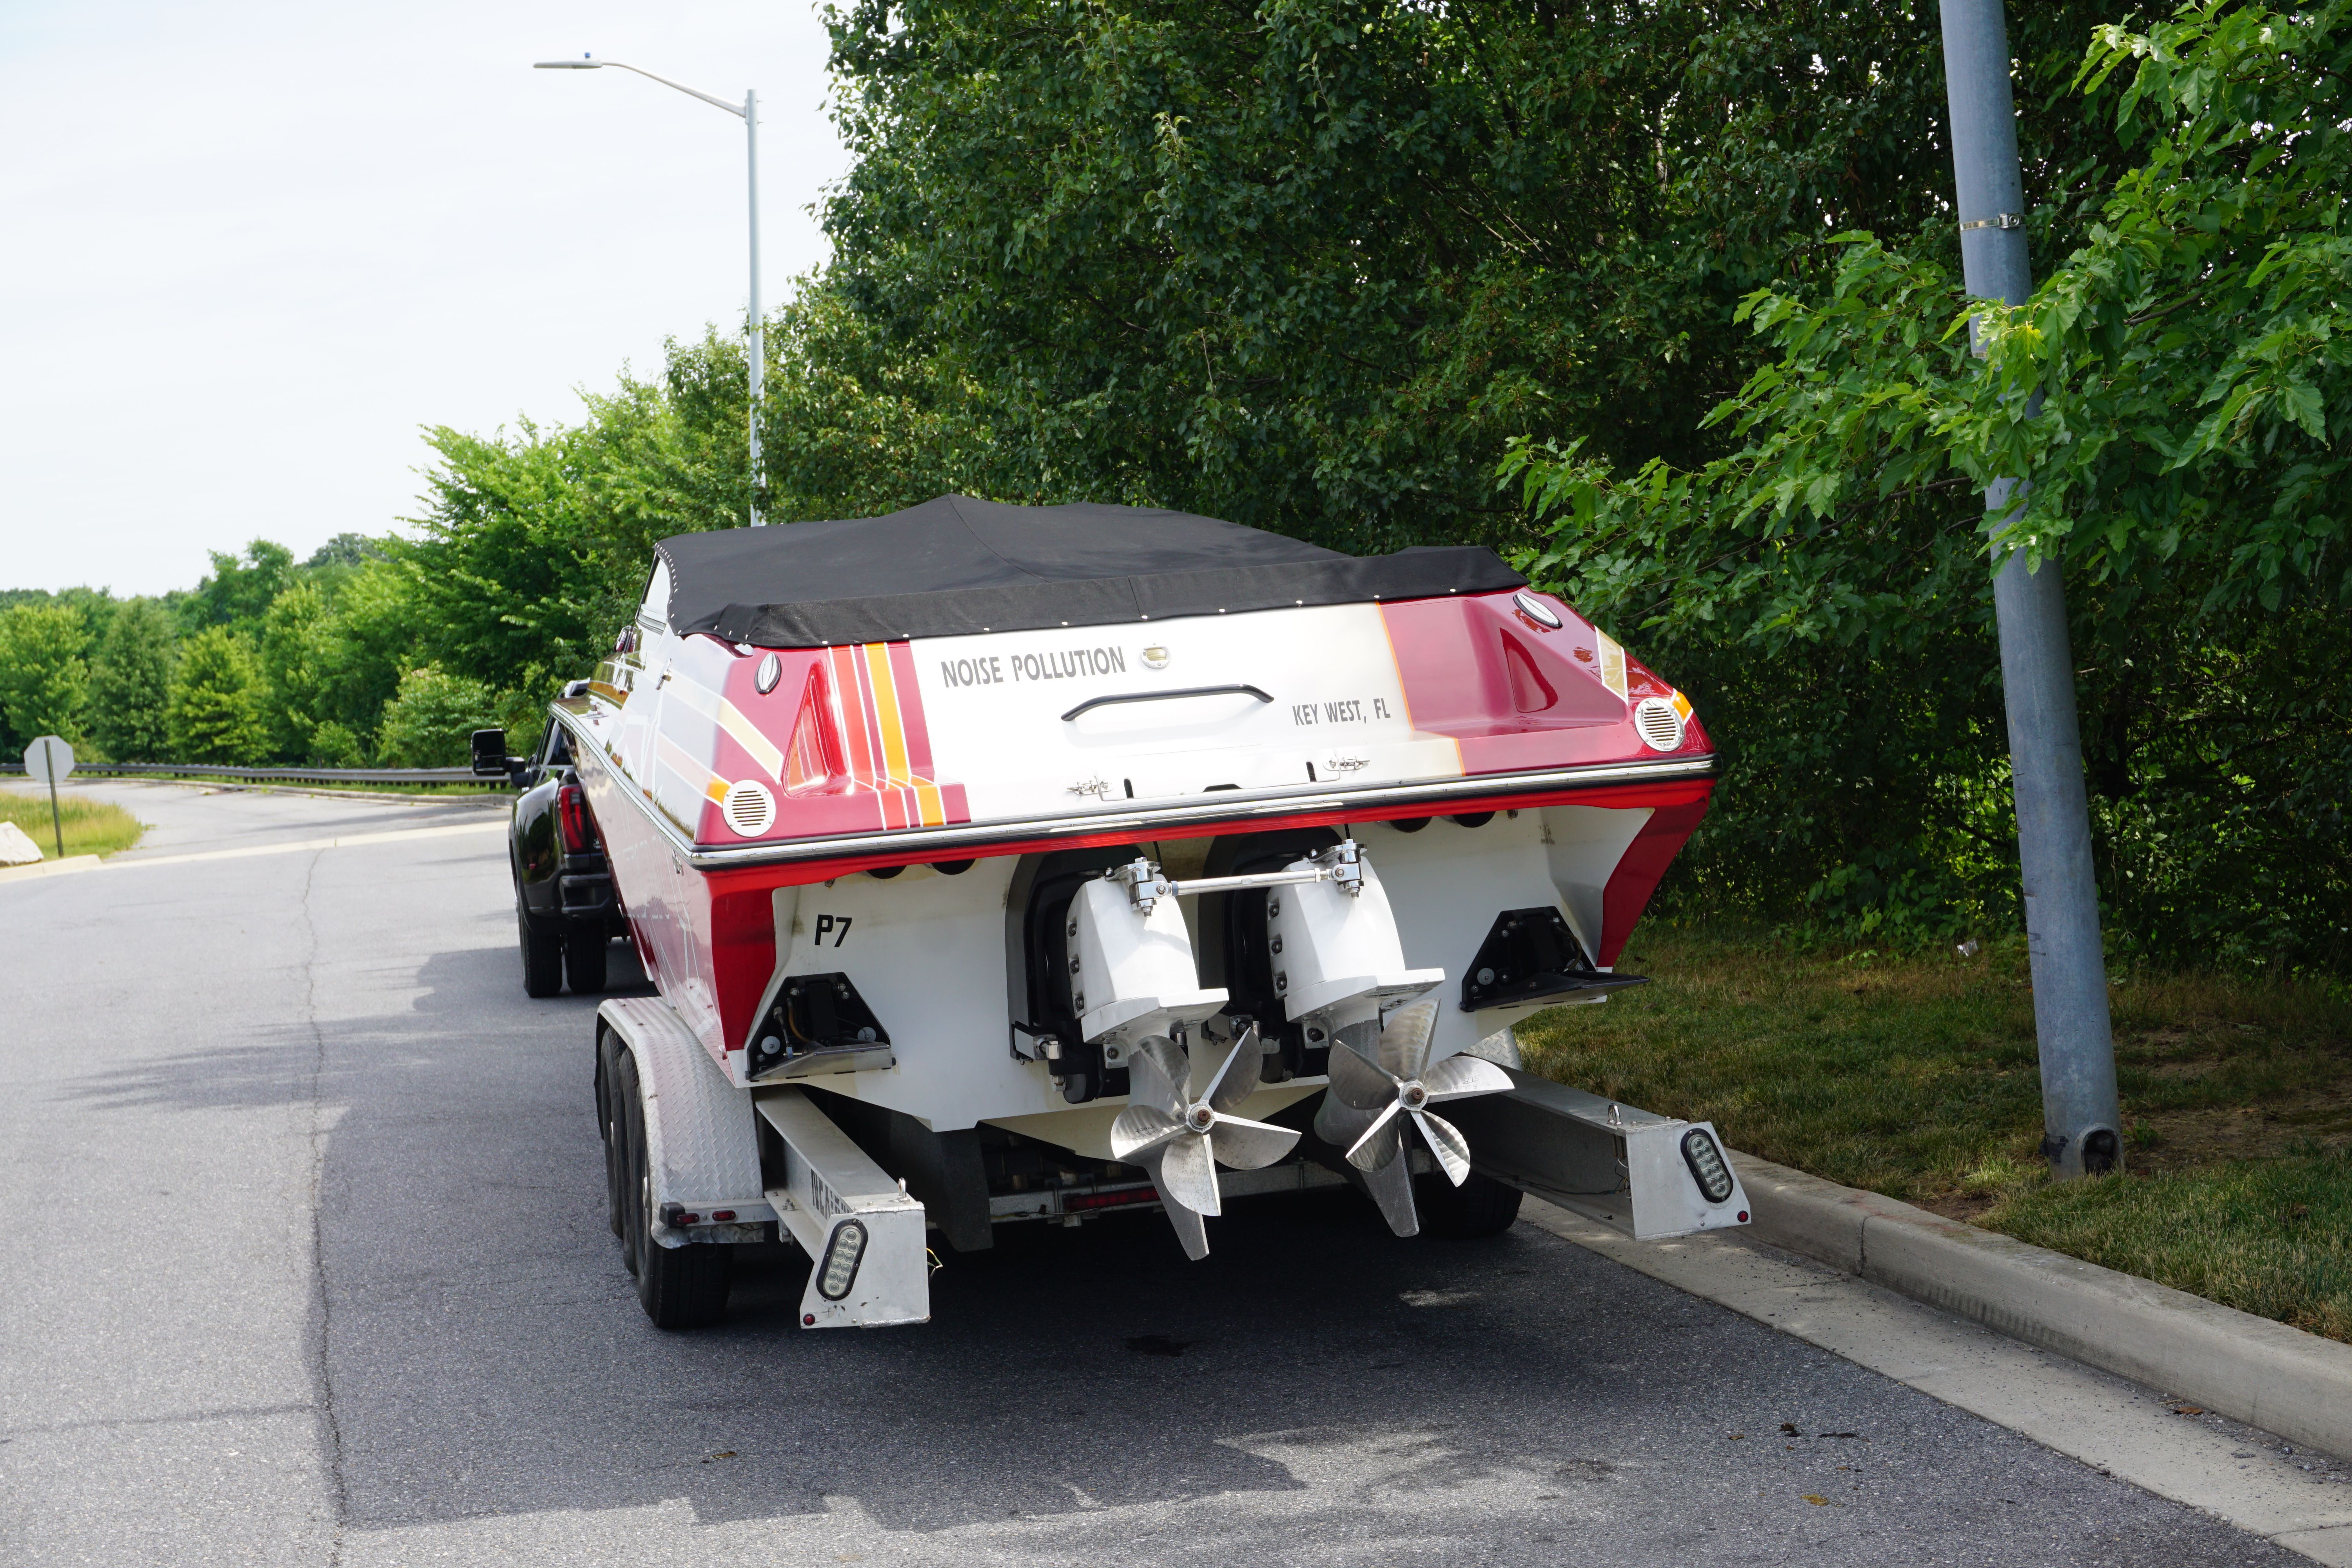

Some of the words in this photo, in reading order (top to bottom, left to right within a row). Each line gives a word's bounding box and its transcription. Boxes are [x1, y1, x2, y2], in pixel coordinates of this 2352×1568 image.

[941, 656, 1004, 688] NOISE
[1011, 646, 1126, 682] POLLUTION
[1292, 703, 1318, 726] KEY
[1323, 700, 1367, 724] WEST,
[1373, 698, 1391, 719] FL
[815, 914, 852, 947] P7
